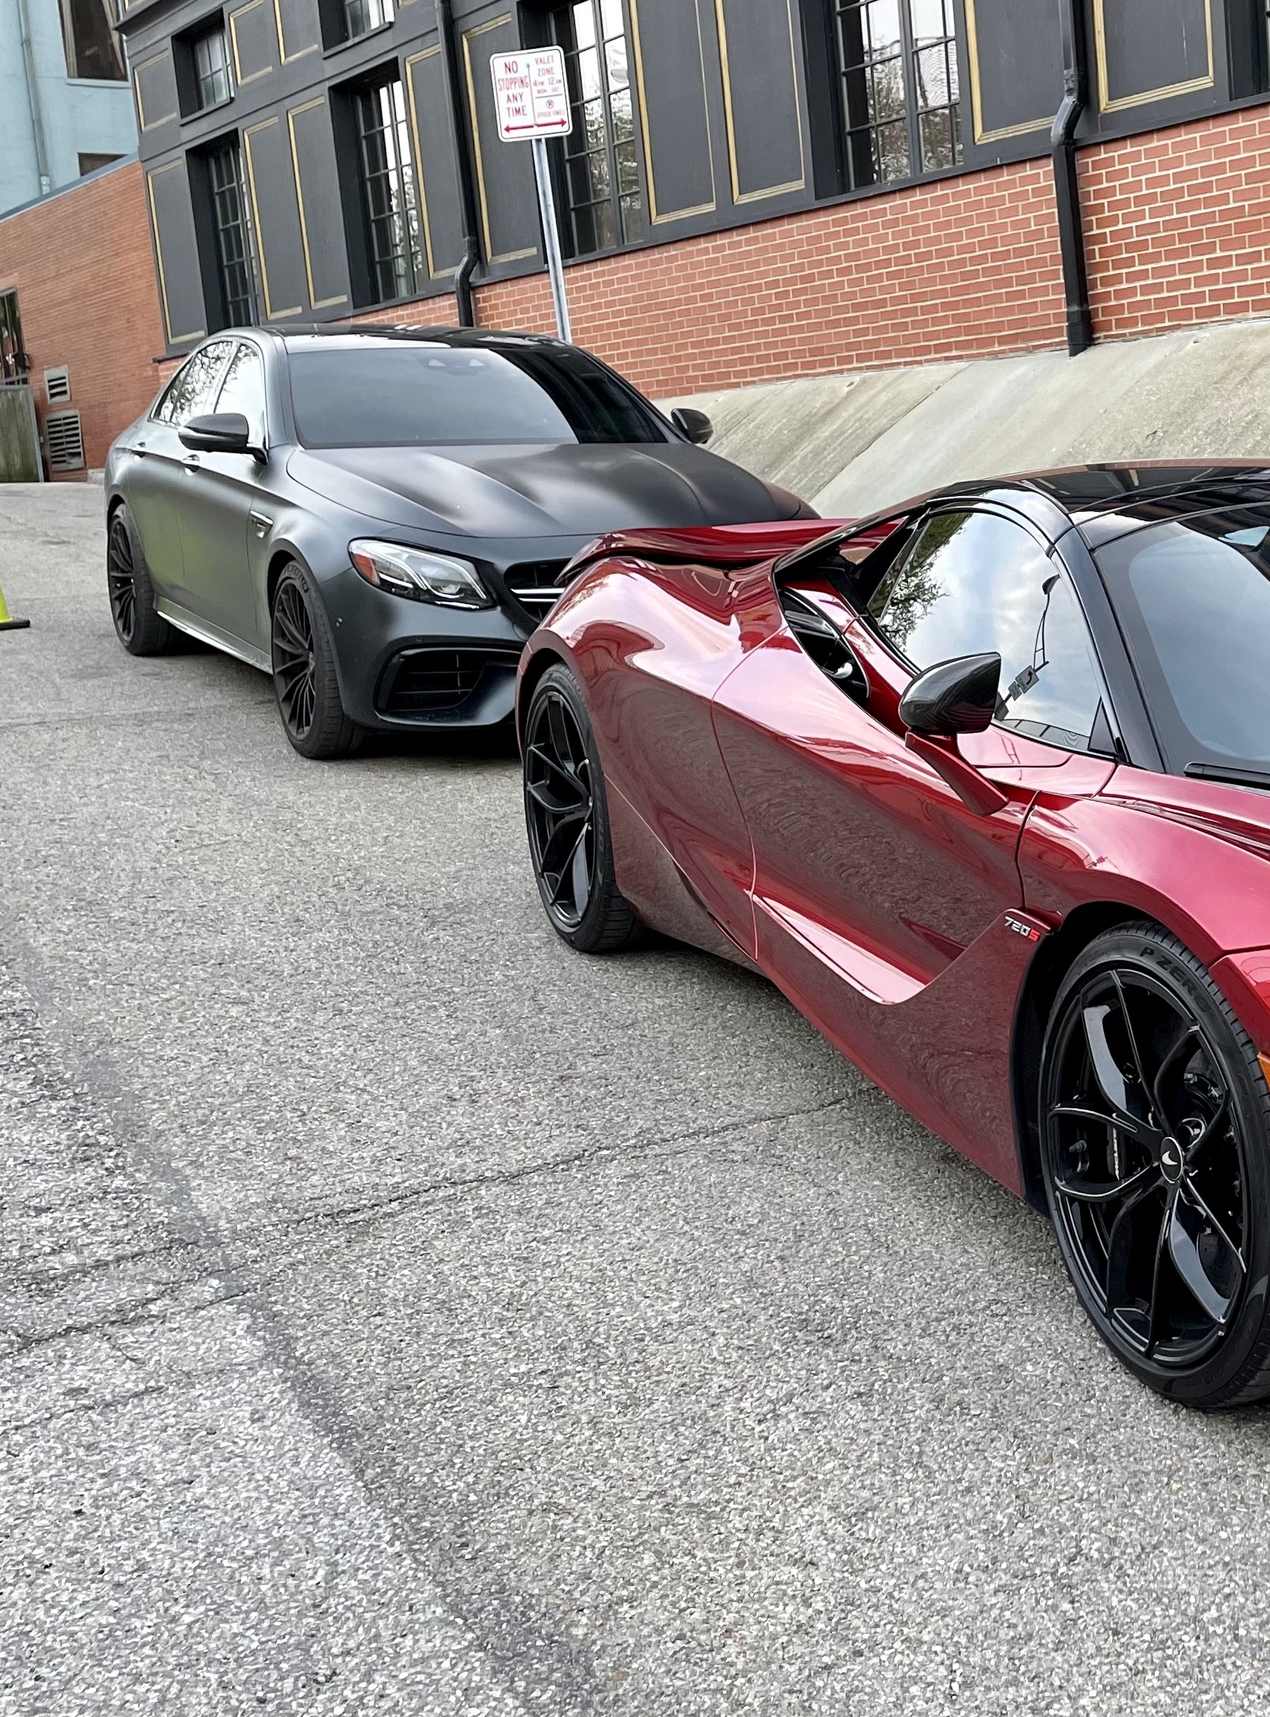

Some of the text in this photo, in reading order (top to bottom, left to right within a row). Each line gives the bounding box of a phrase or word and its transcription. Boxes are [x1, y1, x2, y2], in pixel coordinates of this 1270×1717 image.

[534, 55, 554, 65] VALET
[503, 60, 519, 75] NO
[537, 67, 555, 77] ZONE
[497, 75, 529, 92] STOPPING
[506, 92, 524, 104] ANY
[506, 105, 528, 118] TIME
[1004, 916, 1040, 942] 720S
[1139, 946, 1212, 1013] P ZERO
